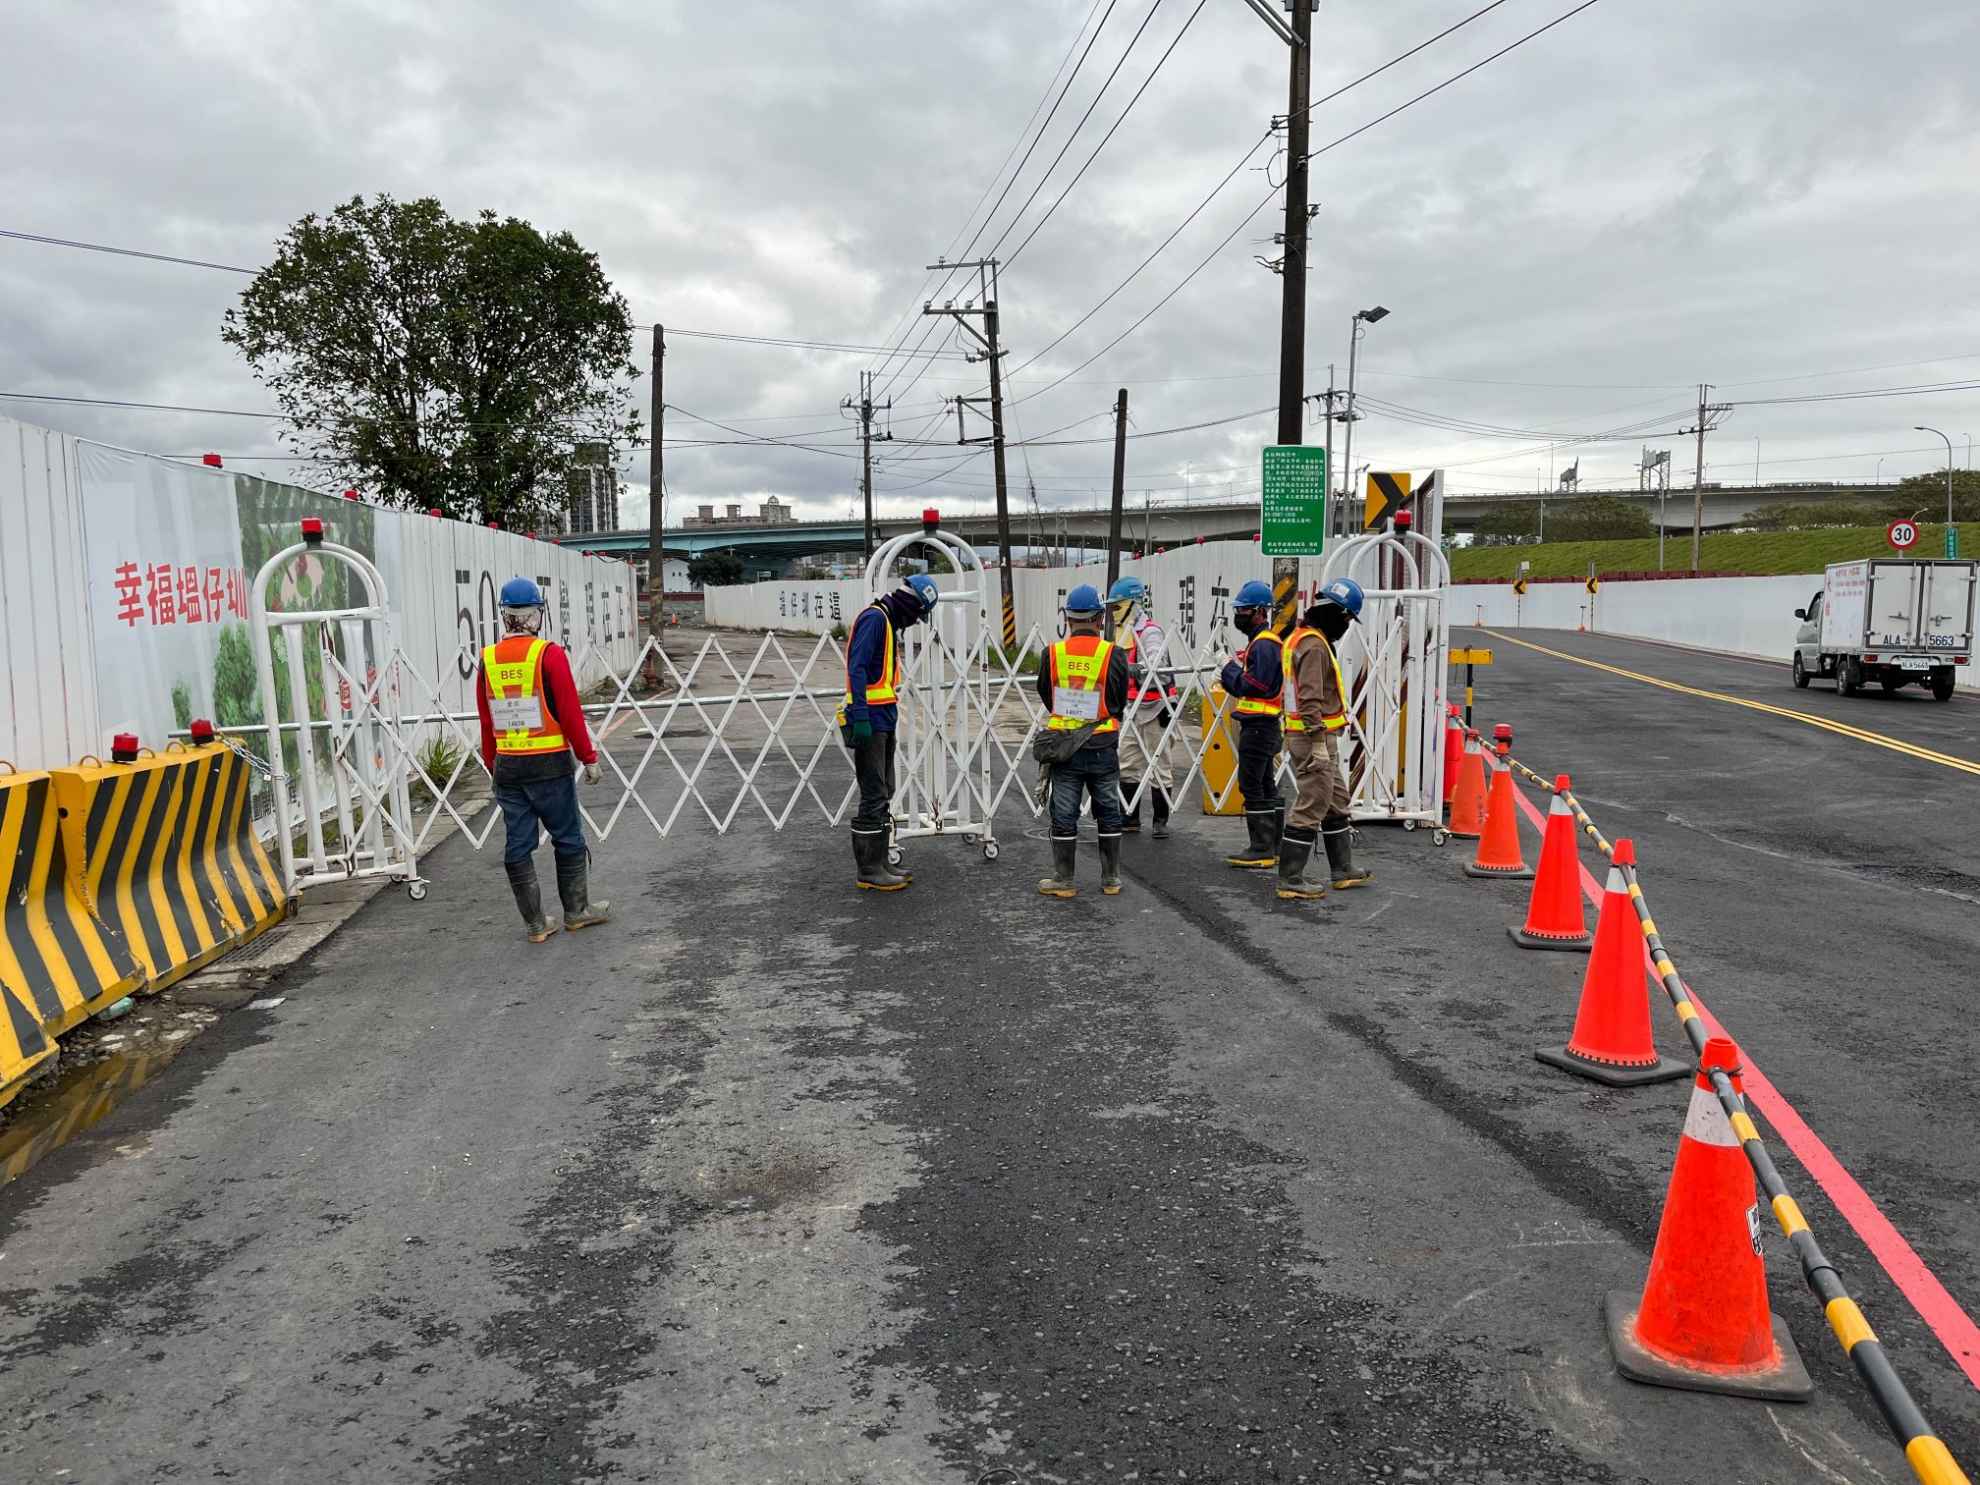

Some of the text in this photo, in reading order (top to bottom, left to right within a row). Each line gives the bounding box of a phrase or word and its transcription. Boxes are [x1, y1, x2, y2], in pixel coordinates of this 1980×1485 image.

[1894, 527, 1912, 542] 30
[114, 560, 249, 628] 幸福塭仔圳
[1929, 635, 1954, 646] 5663
[1067, 661, 1090, 672] BES
[500, 668, 524, 680] BES
